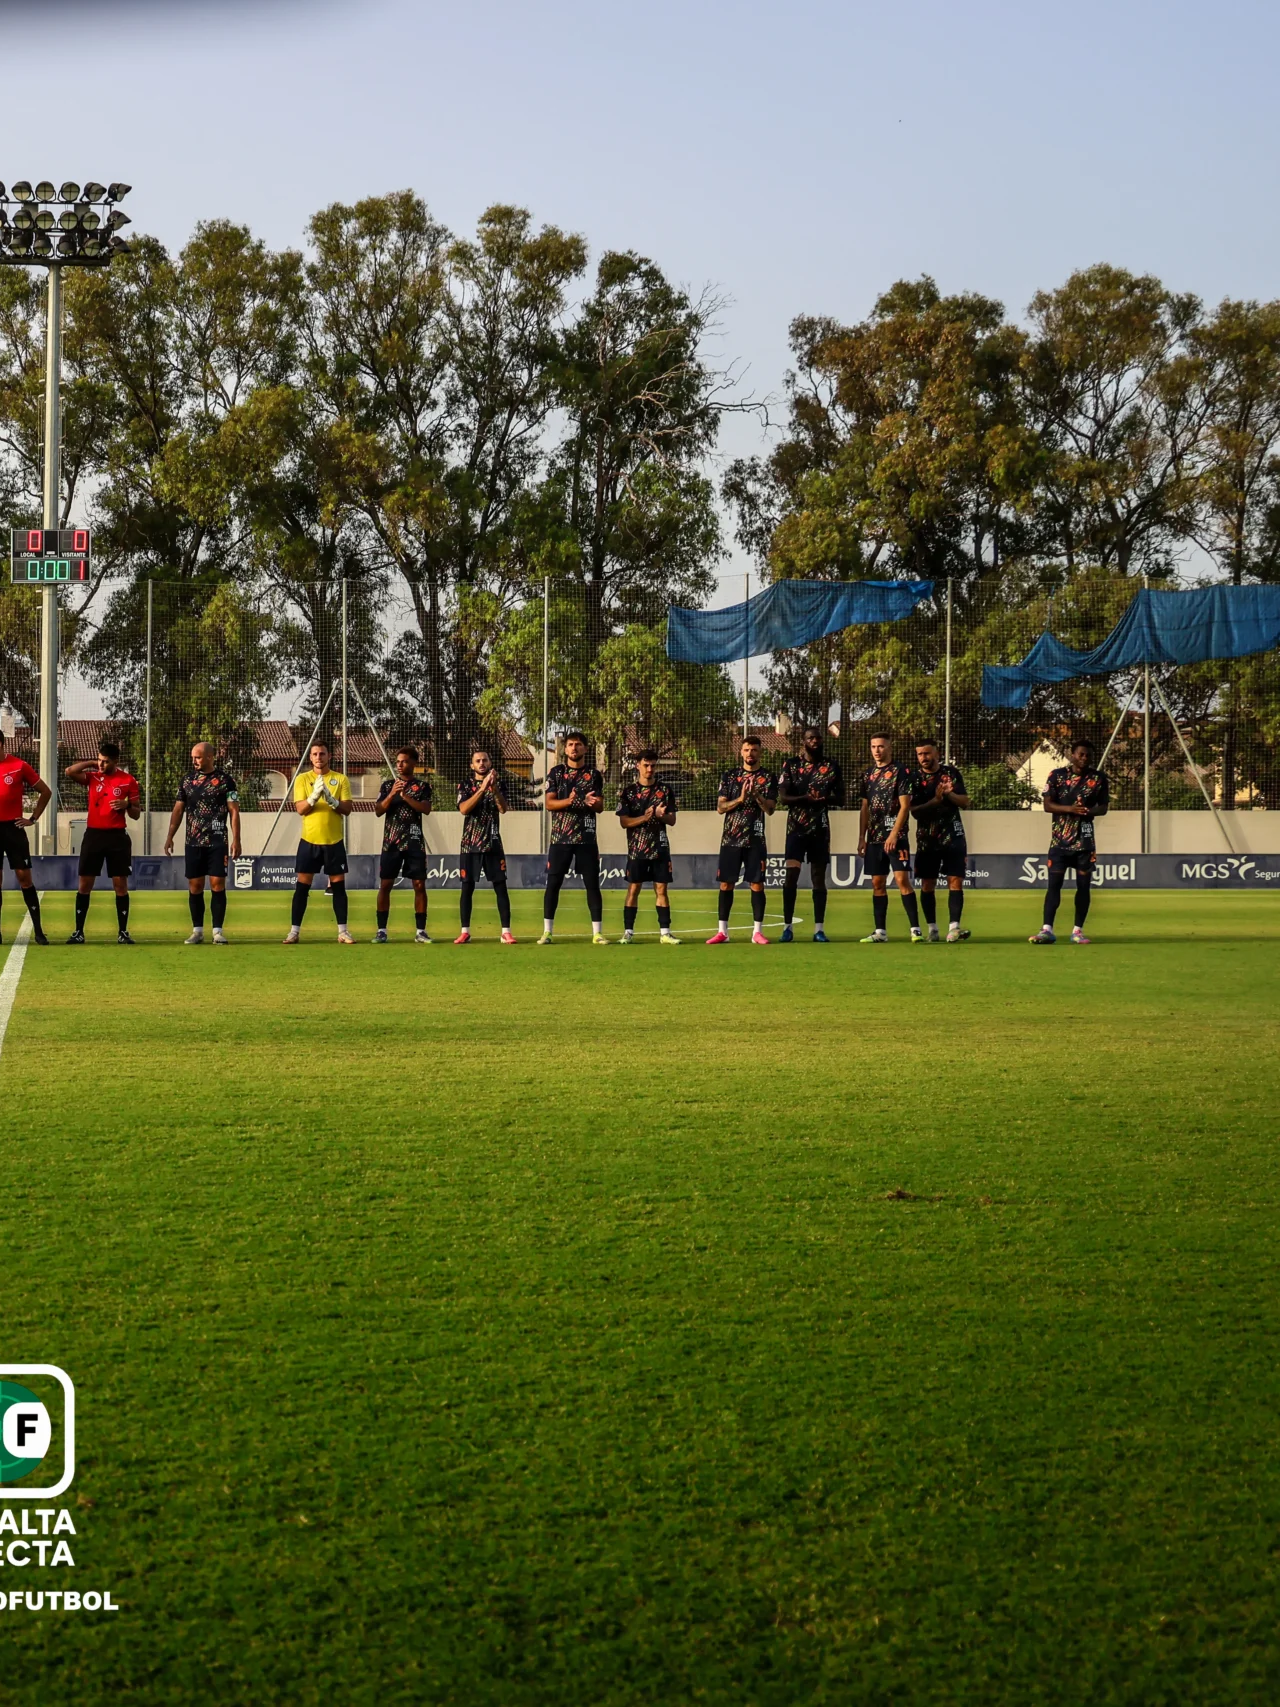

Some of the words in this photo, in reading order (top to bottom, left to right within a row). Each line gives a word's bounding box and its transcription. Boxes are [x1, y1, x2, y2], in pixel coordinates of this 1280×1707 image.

[28, 531, 41, 550] 0
[74, 531, 87, 550] 0
[965, 870, 990, 878] Sabio
[1182, 863, 1230, 879] MGS
